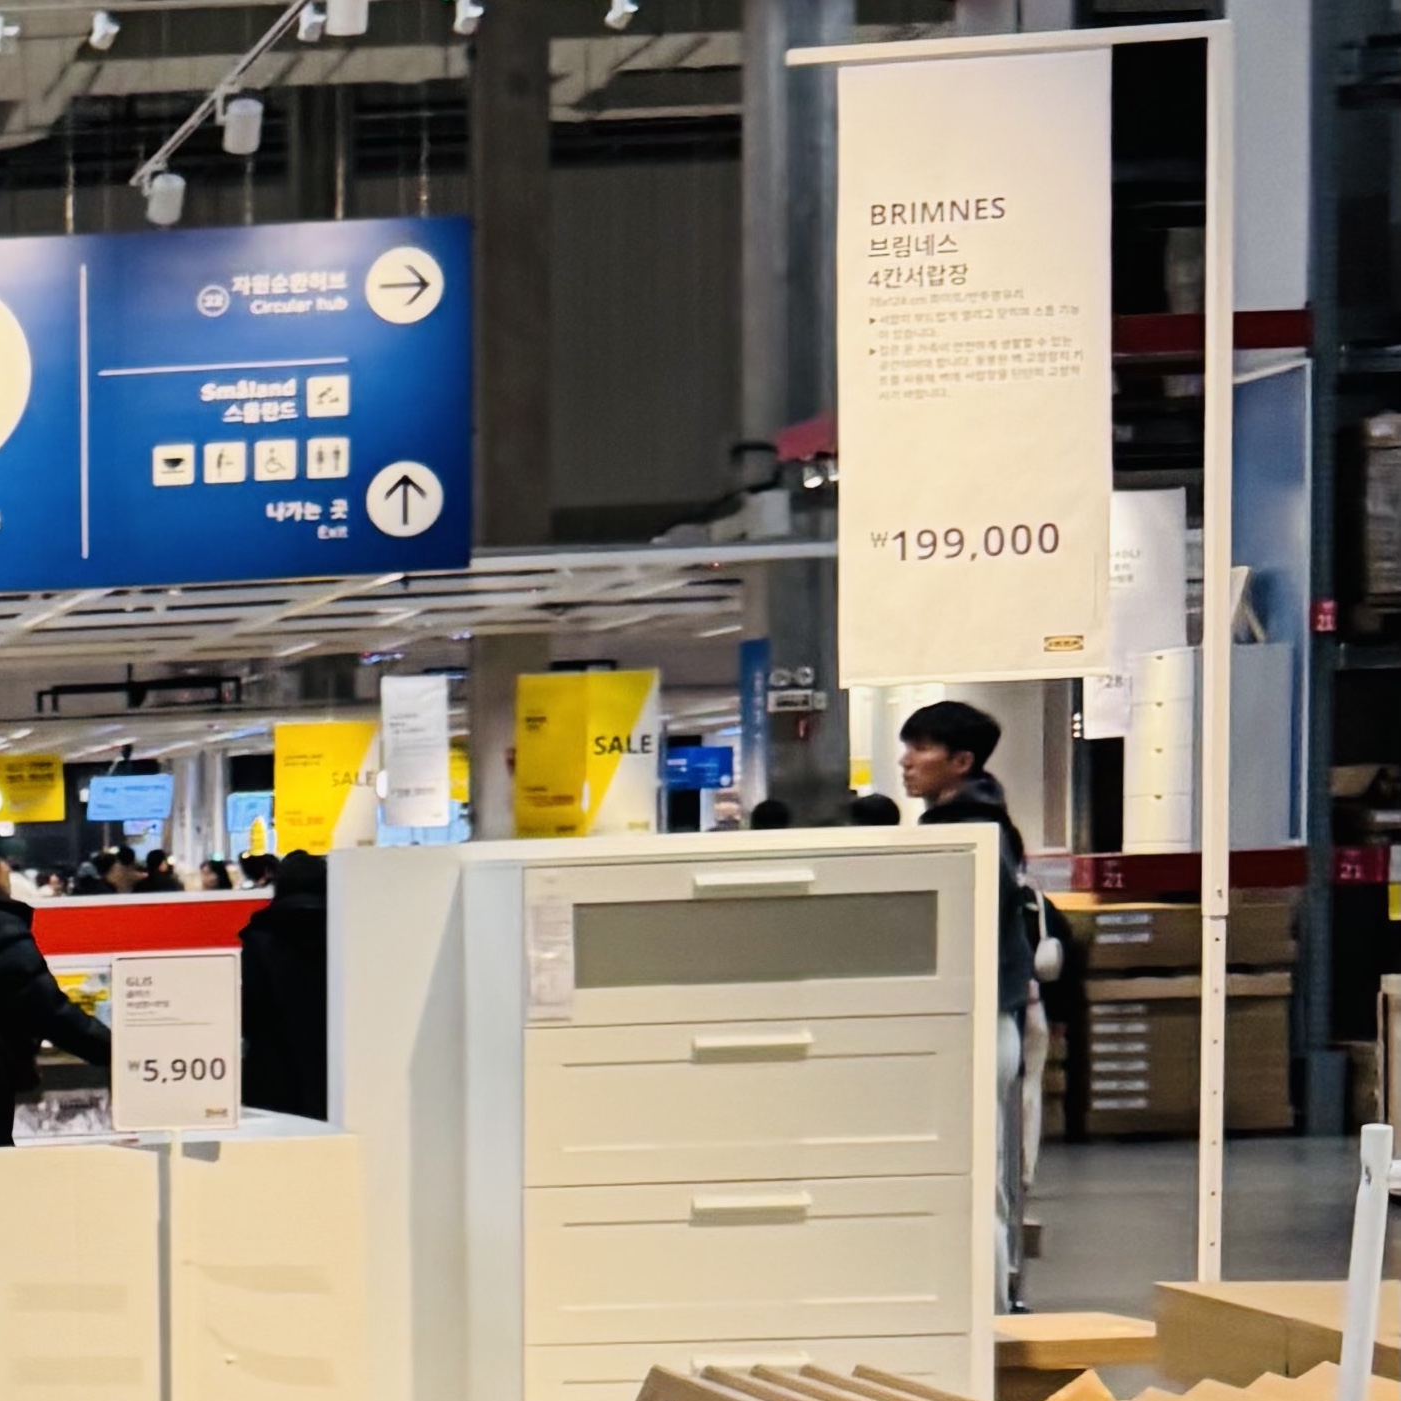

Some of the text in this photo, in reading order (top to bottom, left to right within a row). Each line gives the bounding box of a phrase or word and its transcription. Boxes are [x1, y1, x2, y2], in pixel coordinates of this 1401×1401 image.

[870, 197, 1006, 226] BRIMNES
[867, 233, 959, 258] 브림네스
[231, 271, 348, 296] 자원순환허브
[867, 263, 969, 289] 4칸서랍장
[250, 298, 314, 315] Circular
[265, 498, 349, 522] 나가는 곳
[870, 522, 1060, 562] ₩199,000
[592, 734, 653, 755] SALE
[332, 771, 375, 787] SALE
[127, 1057, 227, 1084] ₩5,900
